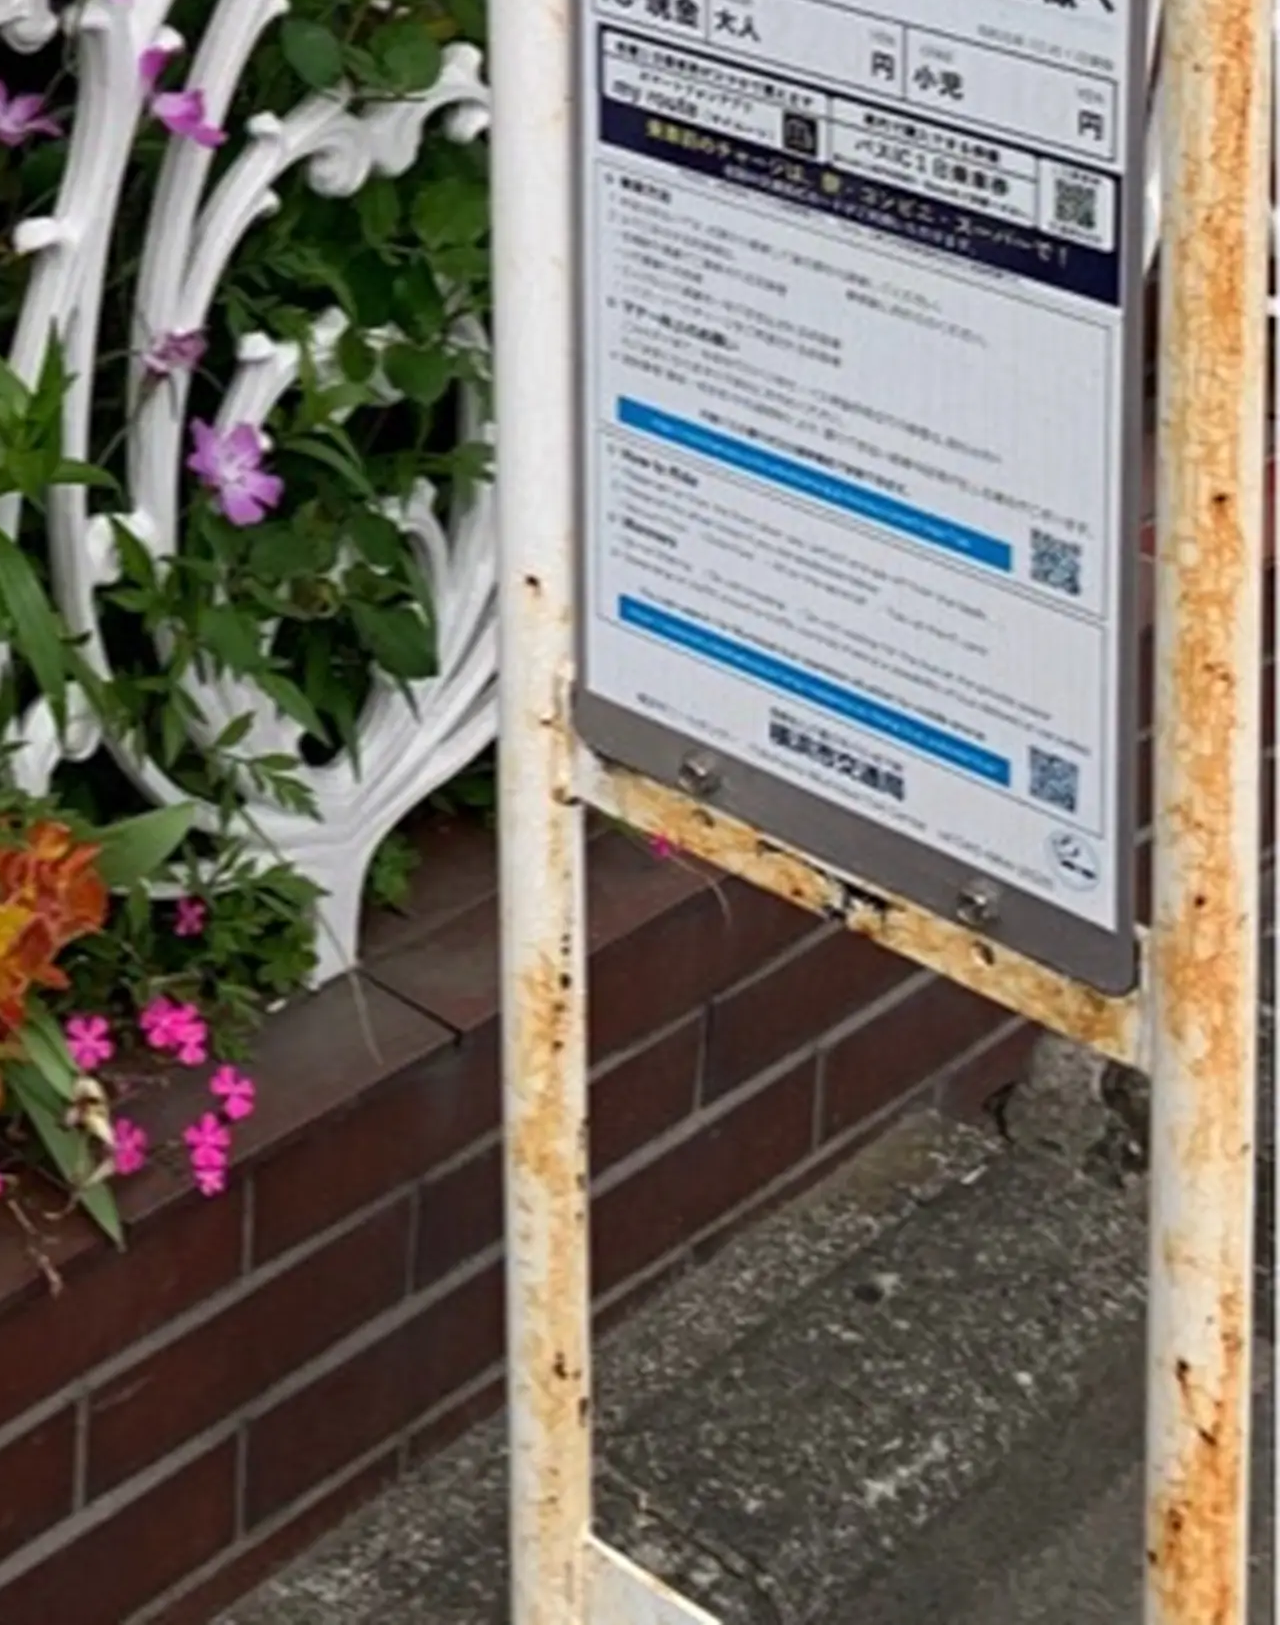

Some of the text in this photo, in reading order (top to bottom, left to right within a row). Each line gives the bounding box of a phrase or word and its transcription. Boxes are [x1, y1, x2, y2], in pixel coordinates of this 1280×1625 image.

[713, 7, 896, 81] 大人 円
[914, 66, 1105, 141] 小児 円
